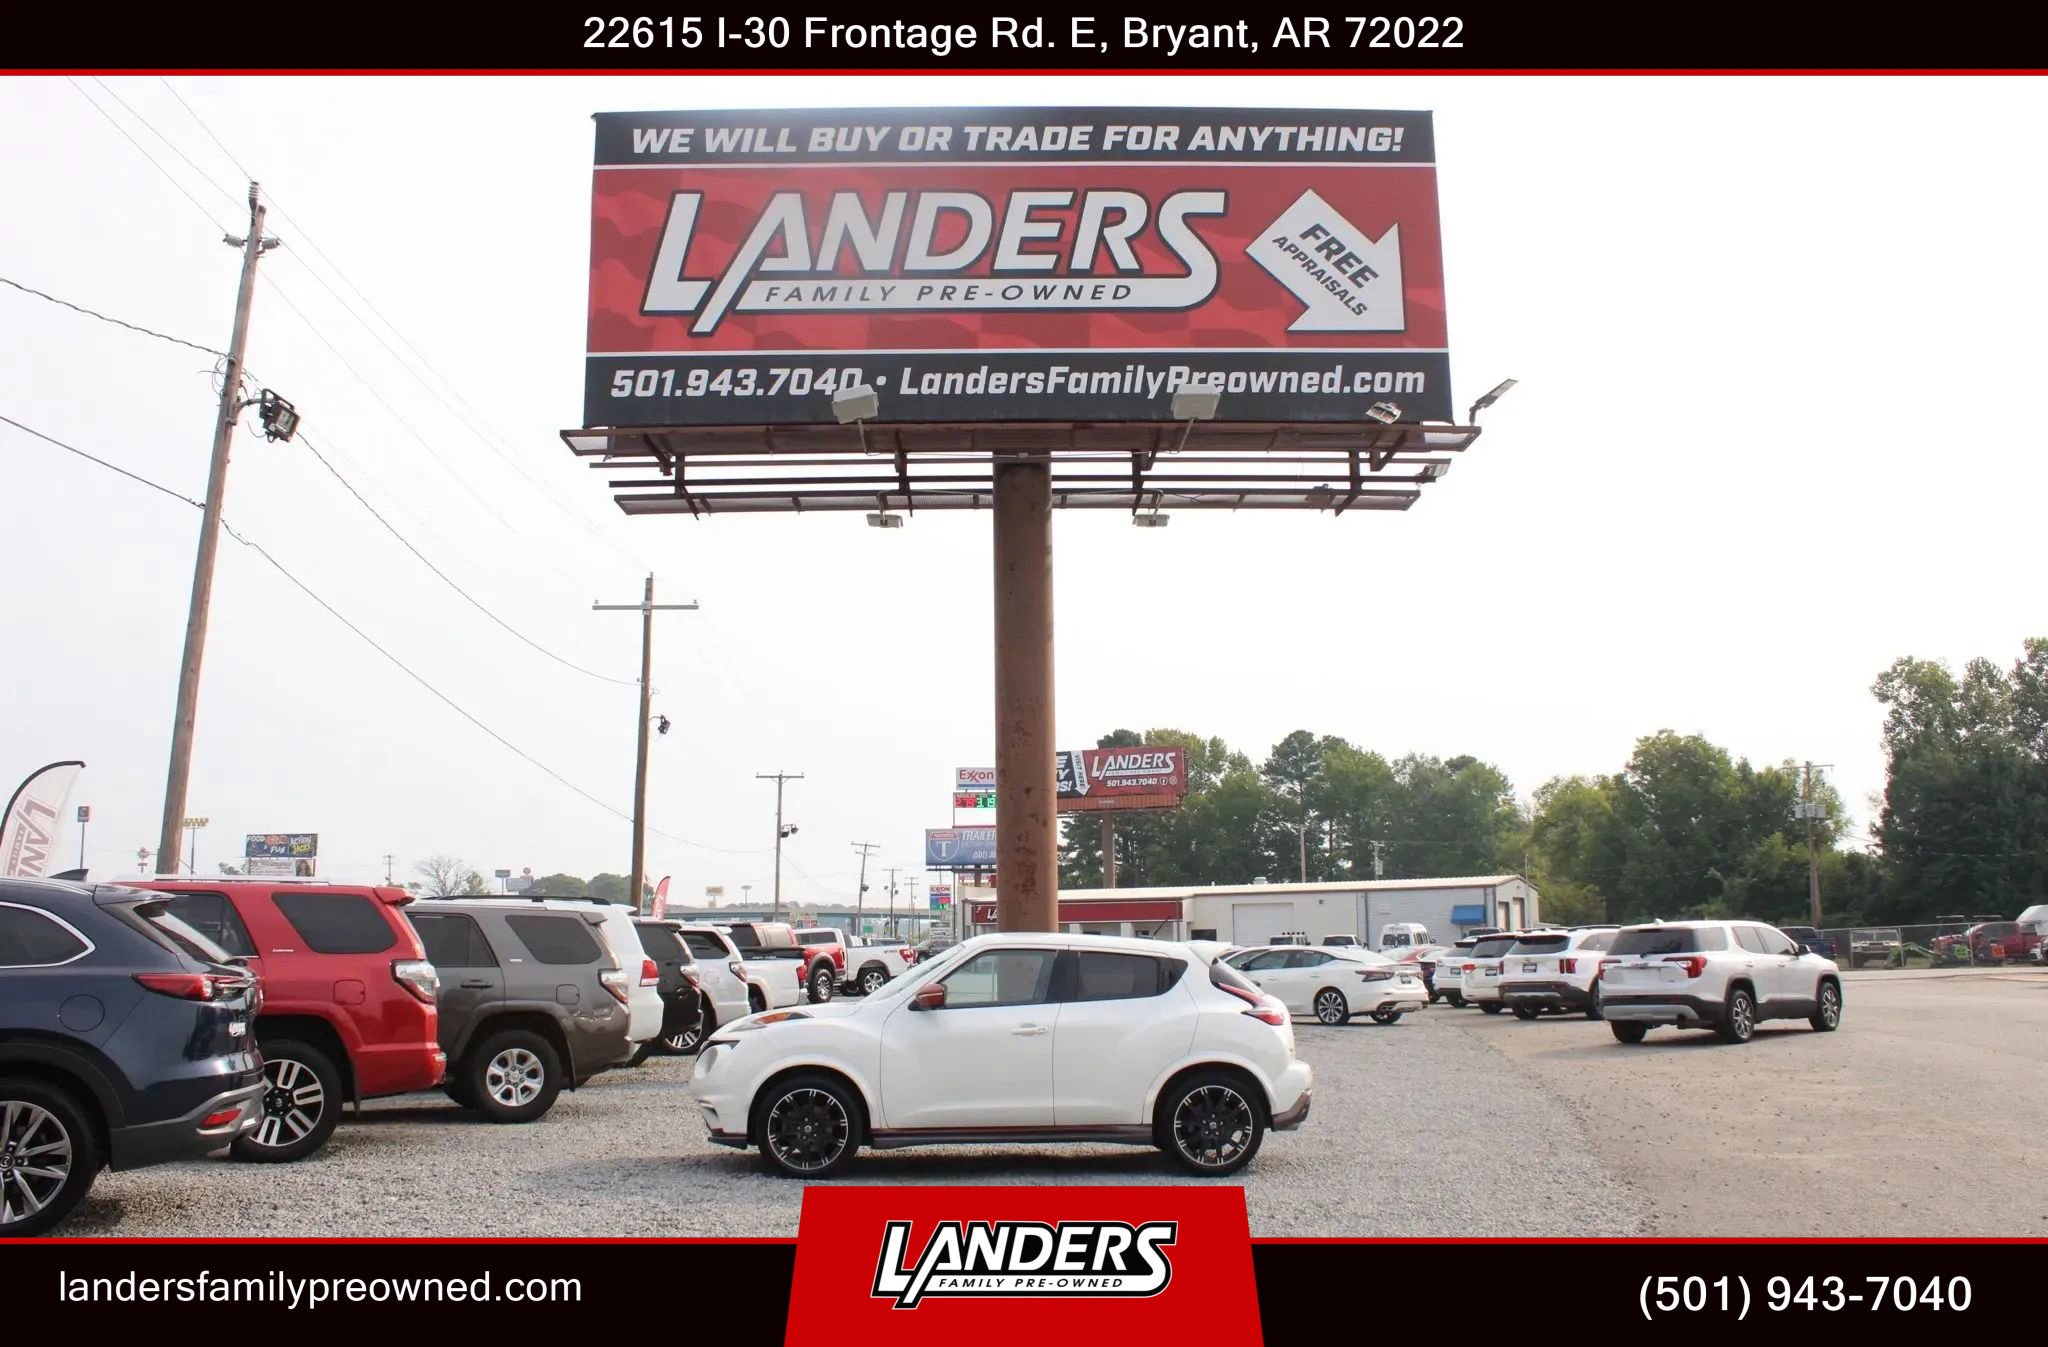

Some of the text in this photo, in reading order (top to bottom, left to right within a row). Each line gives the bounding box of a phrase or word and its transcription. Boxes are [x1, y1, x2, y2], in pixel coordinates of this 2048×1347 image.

[633, 125, 1405, 154] WE WILL BUY OR TRADE FOR ANYTHING!
[641, 190, 1228, 335] LANDERS
[1299, 222, 1379, 290] FREE
[1271, 235, 1368, 317] APPRAISALS
[765, 283, 1132, 303] FAMILY PRE-OWNED
[610, 367, 863, 398] 501.943.7040
[900, 364, 1425, 400] LandersFamilyPreowned.com
[959, 769, 994, 783] Exxon
[1091, 752, 1176, 781] LANDERS
